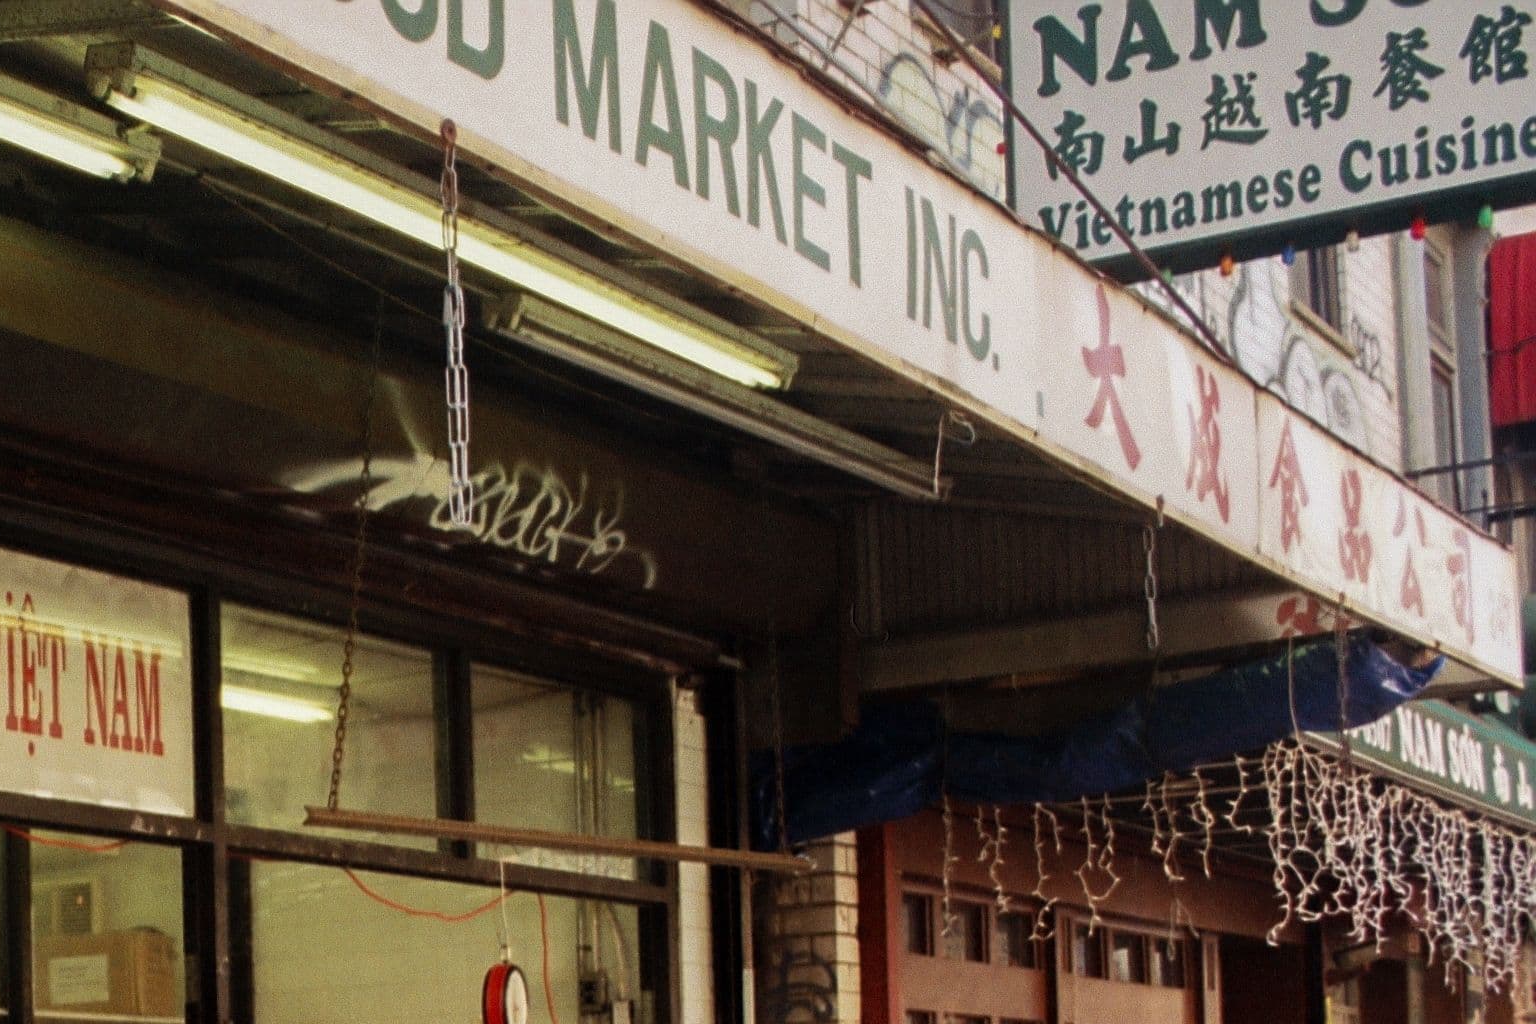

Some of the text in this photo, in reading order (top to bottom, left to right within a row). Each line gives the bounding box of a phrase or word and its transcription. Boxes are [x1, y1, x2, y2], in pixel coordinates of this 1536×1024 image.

[1033, 0, 1267, 98] NAM
[1045, 5, 1532, 181] 南山越南餐館
[551, 0, 873, 289] MARKET
[904, 186, 999, 372] INC.
[1037, 162, 1322, 251] Vietnamese
[80, 626, 165, 757] NAM
